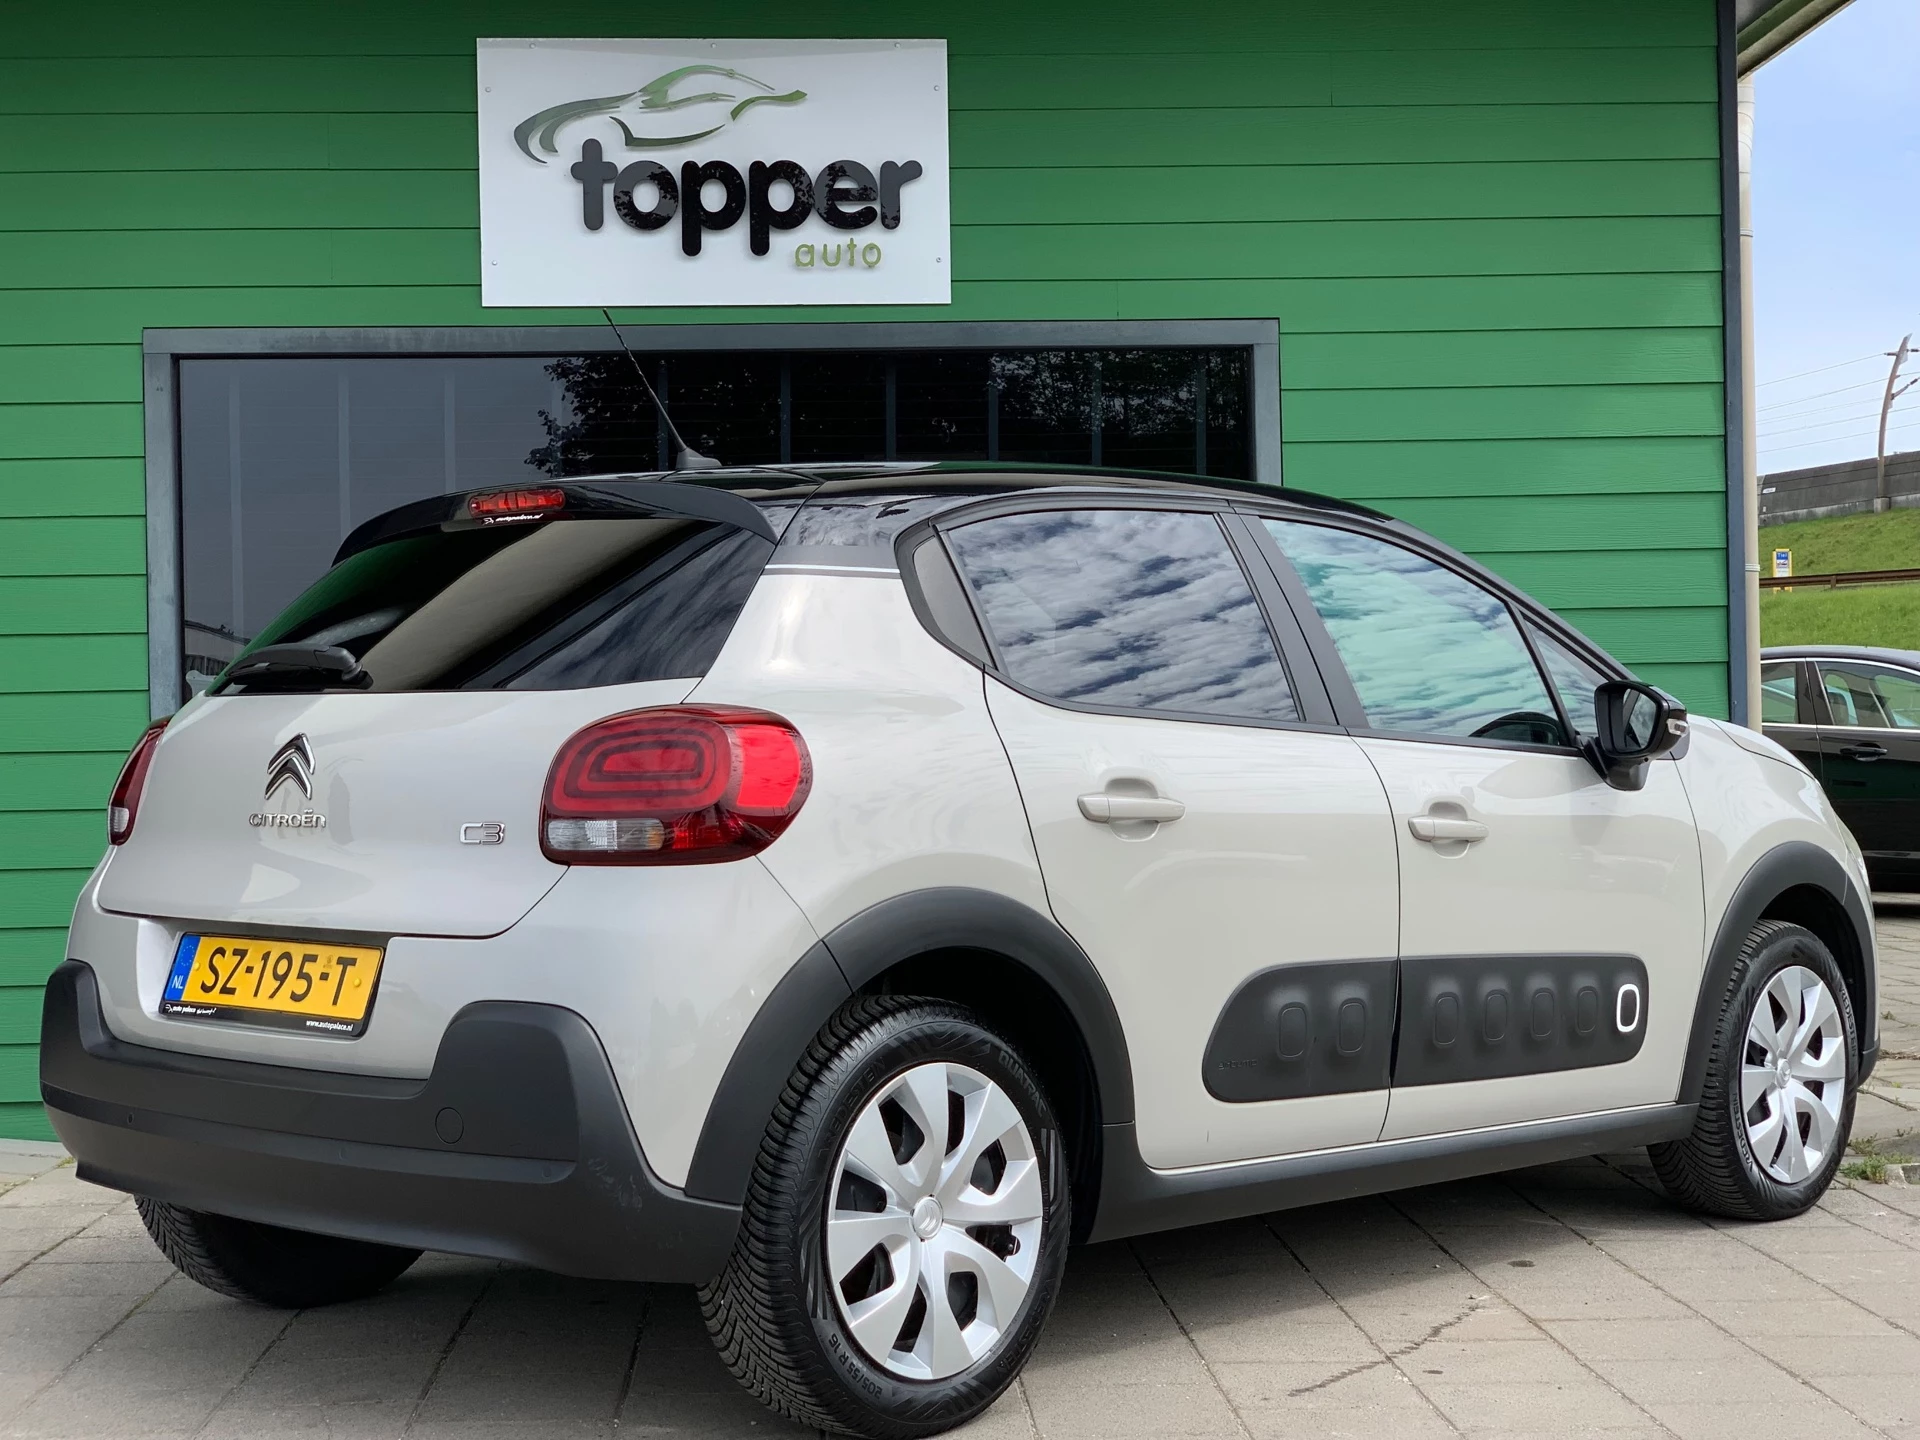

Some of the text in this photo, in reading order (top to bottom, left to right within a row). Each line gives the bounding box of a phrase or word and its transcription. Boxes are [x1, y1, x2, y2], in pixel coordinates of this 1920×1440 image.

[570, 138, 923, 257] topper
[794, 237, 882, 268] auto
[459, 822, 505, 845] C3
[171, 974, 185, 990] NL
[199, 946, 358, 1007] SZ-195-T
[305, 1020, 354, 1032] www.autopalace.nl
[828, 1332, 883, 1399] 205/55 R 16
